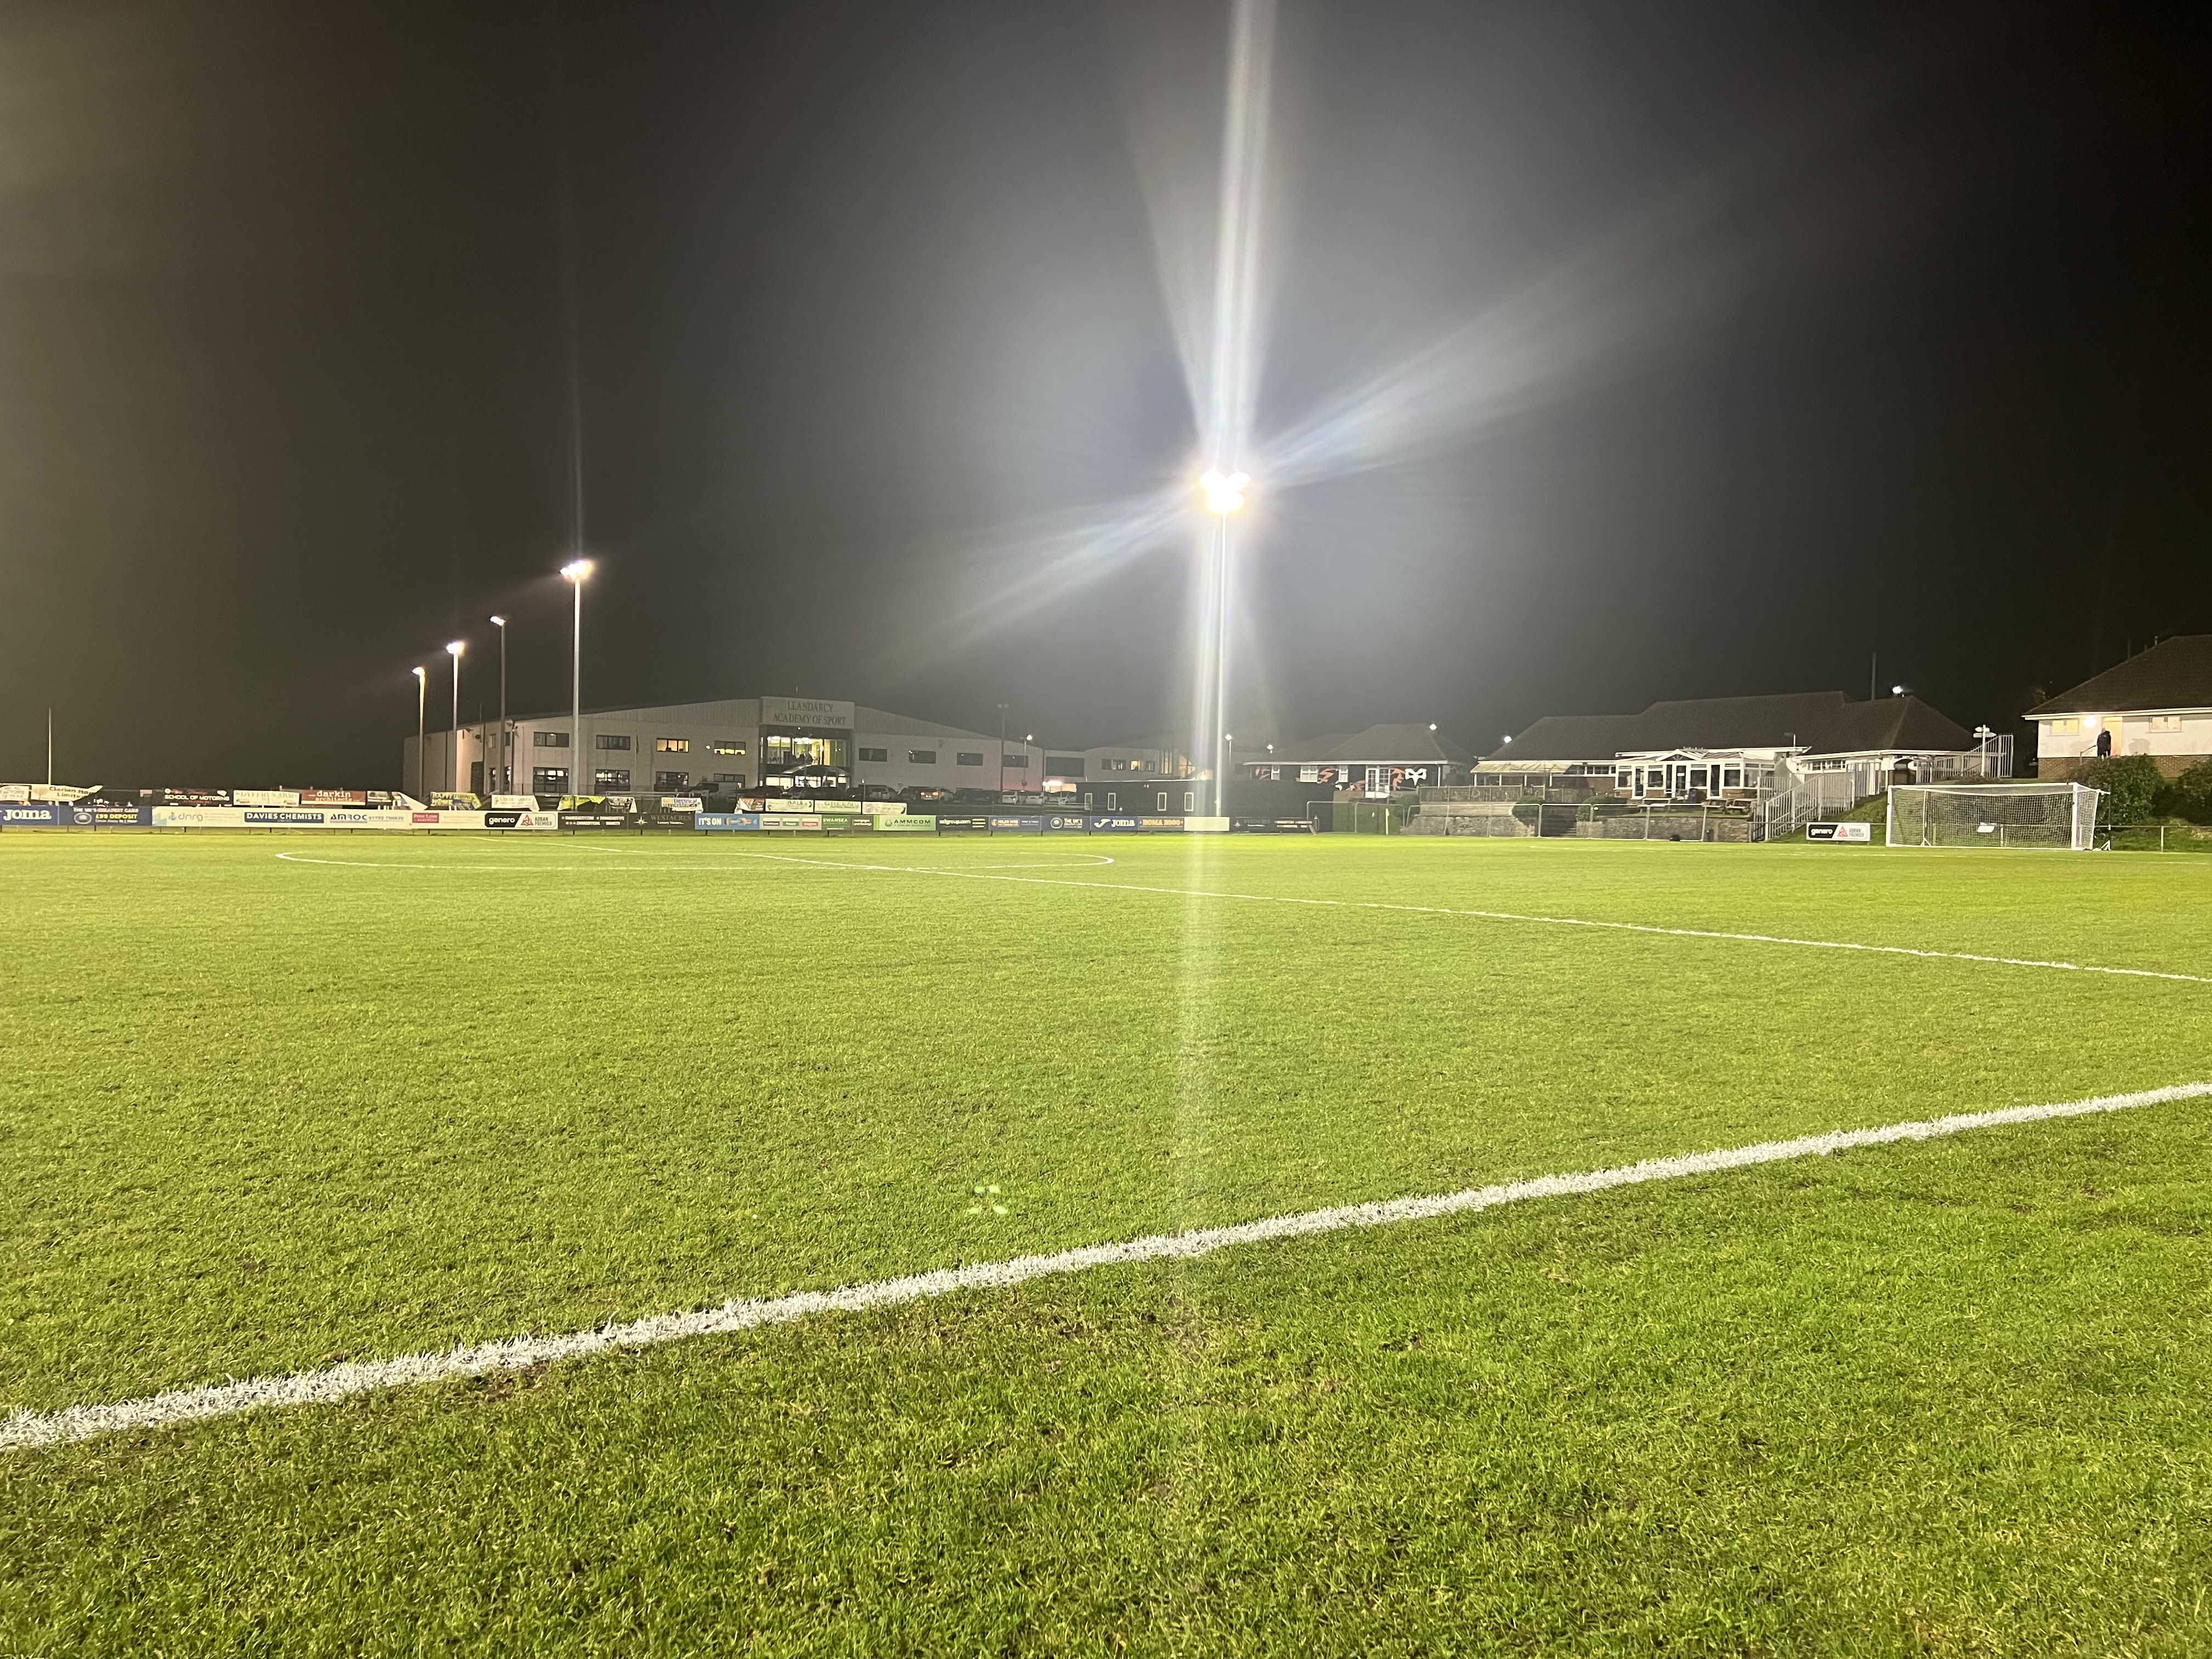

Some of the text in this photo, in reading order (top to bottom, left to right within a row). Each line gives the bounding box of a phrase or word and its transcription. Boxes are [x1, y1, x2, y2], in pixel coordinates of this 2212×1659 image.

[787, 701, 834, 713] LLANDARCY
[772, 713, 847, 726] ACADEMY OF SPORT
[178, 812, 204, 822] dnrg
[488, 817, 515, 825] genero
[698, 817, 722, 826] IT'S ON
